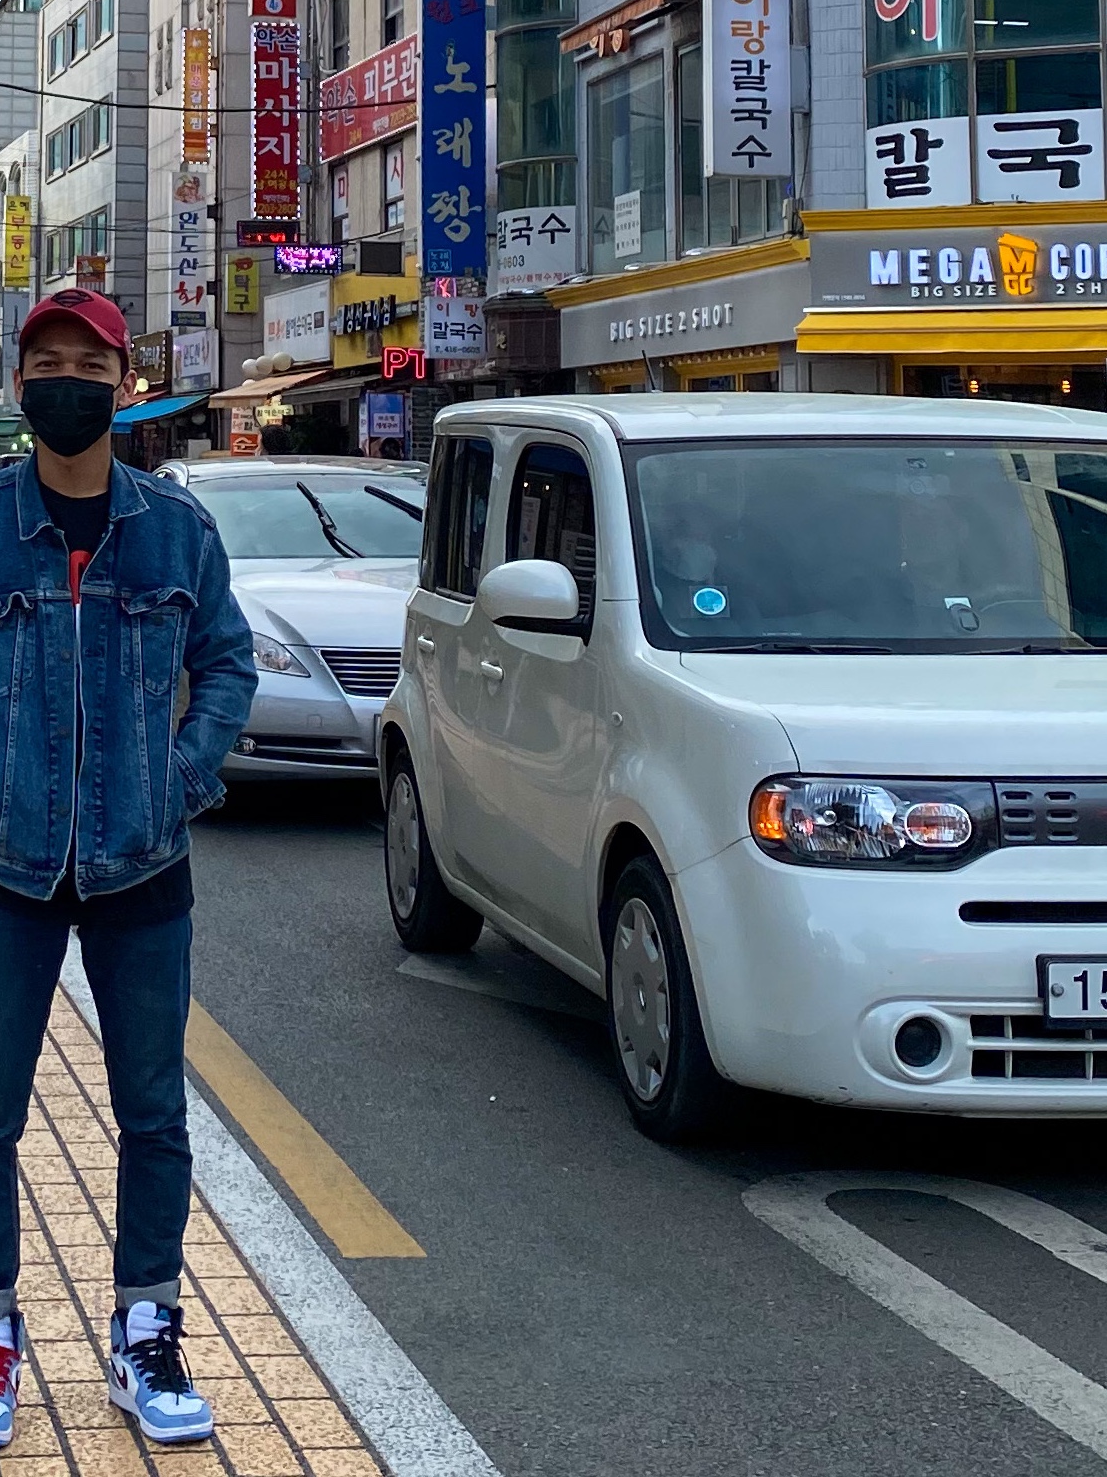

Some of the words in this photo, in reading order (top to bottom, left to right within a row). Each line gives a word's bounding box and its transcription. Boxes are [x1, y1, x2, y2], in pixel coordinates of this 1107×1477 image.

[257, 27, 297, 53] 약손
[257, 57, 297, 165] 마사지
[730, 59, 772, 169] 칼국수
[876, 119, 1092, 199] 칼국
[11, 215, 25, 268] 부동산
[179, 212, 199, 276] 완도산
[497, 213, 571, 249] 칼국수
[870, 247, 996, 285] MEGA
[174, 281, 205, 307] 회
[911, 286, 944, 298] BIG
[953, 284, 997, 297] SIZE
[1056, 283, 1066, 295] 2
[433, 322, 482, 341] 칼국수
[610, 319, 633, 341] BIG
[639, 313, 673, 337] SIZE
[678, 311, 687, 331] 2
[692, 303, 733, 328] SHOT
[384, 347, 426, 379] PT
